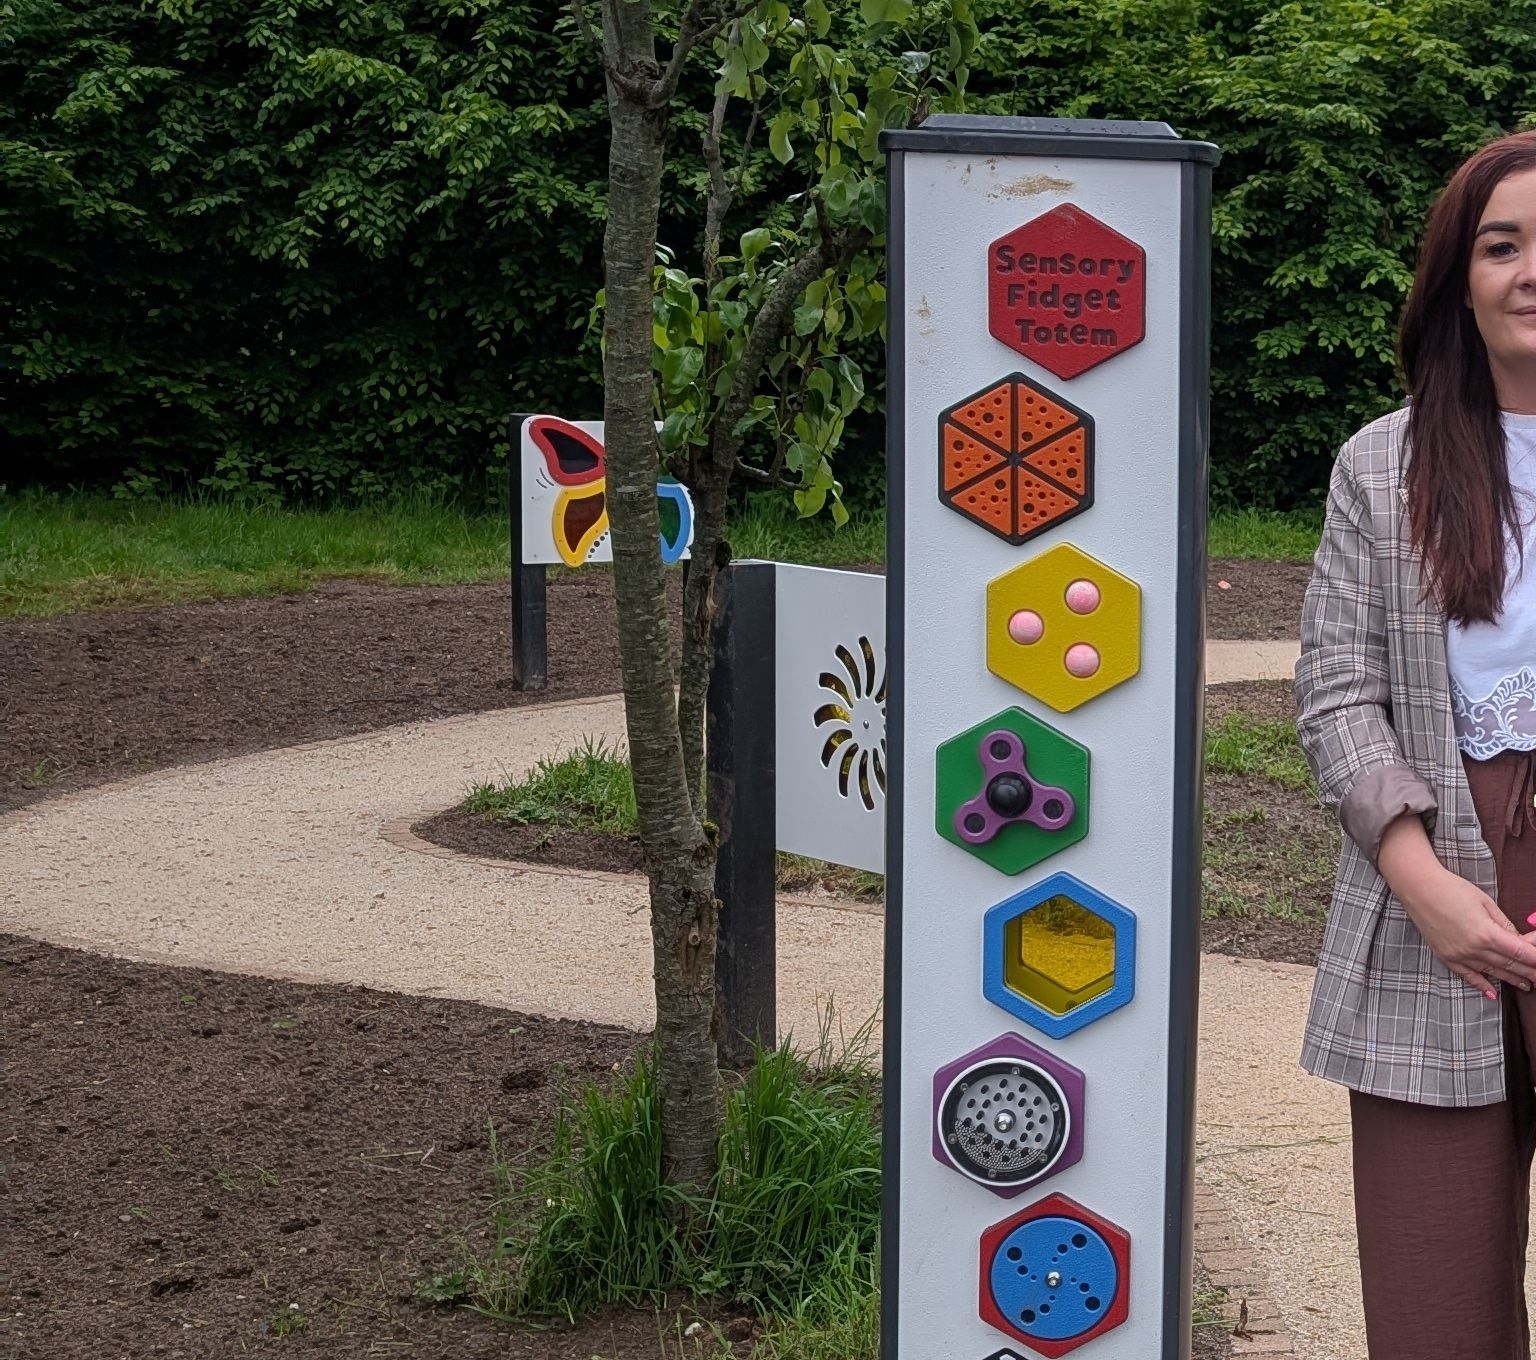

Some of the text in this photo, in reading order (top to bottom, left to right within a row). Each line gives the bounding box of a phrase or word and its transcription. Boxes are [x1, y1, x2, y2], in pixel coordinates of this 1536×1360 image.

[995, 245, 1136, 284] Sensory
[1007, 279, 1122, 318] Fidget
[1014, 319, 1118, 347] Totem
